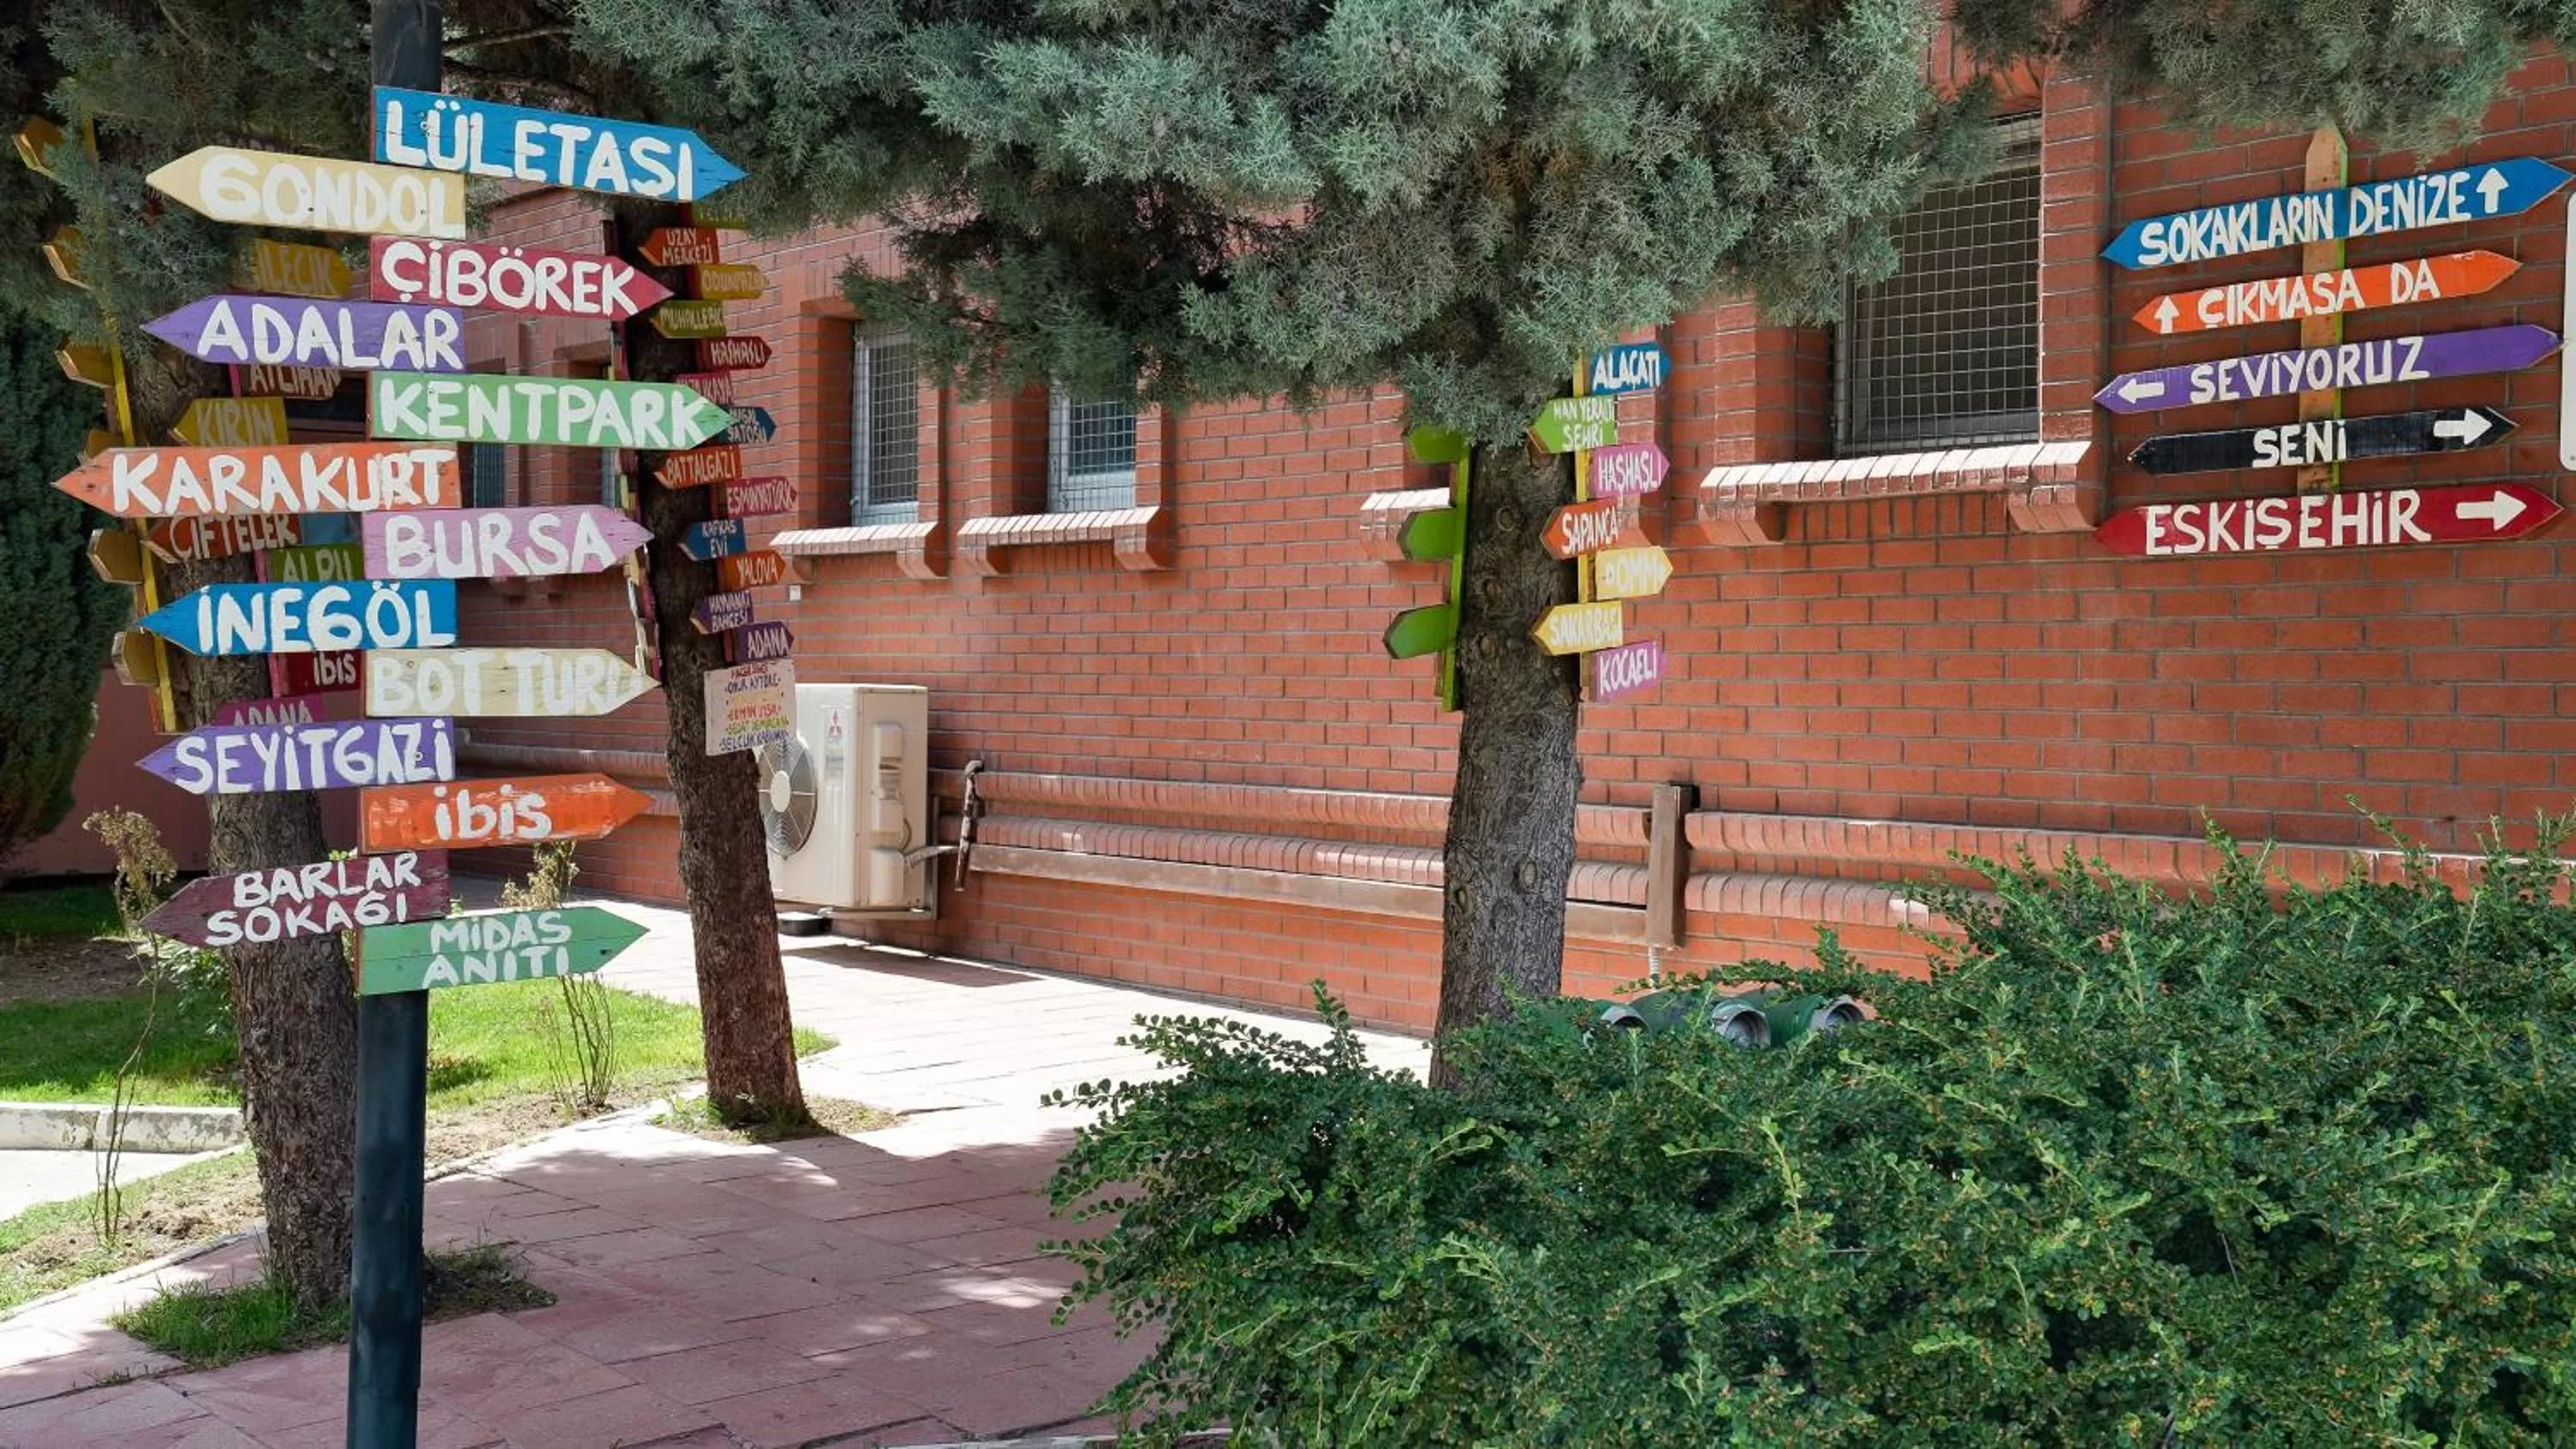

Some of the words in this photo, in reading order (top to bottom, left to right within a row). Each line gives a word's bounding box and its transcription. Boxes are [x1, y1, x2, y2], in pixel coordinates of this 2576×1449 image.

[199, 153, 465, 239] GONDOL
[2138, 193, 2335, 265] SOKAKLARIN
[2349, 172, 2472, 233] DENİZE
[380, 241, 640, 317] ÇİBÖREK
[2197, 269, 2366, 328] ÇIKMASA
[2391, 259, 2441, 304] DA
[197, 299, 464, 369] ADALAR
[2190, 336, 2431, 404] SEVİYORUZ
[380, 378, 708, 446] KENTPARK
[2251, 420, 2348, 468] SENİ
[112, 450, 457, 513] KARAKURT
[385, 512, 619, 578] BURSA
[2146, 488, 2433, 556] ESKİŞEHİR
[737, 555, 779, 588] YALOVA
[197, 581, 457, 653] İNEGÖL
[748, 627, 789, 659] ADANA
[374, 652, 495, 715] BOT
[174, 719, 456, 794] SEYİTGAZİ
[234, 852, 422, 908] BARLAR
[422, 945, 570, 990] ANITI
